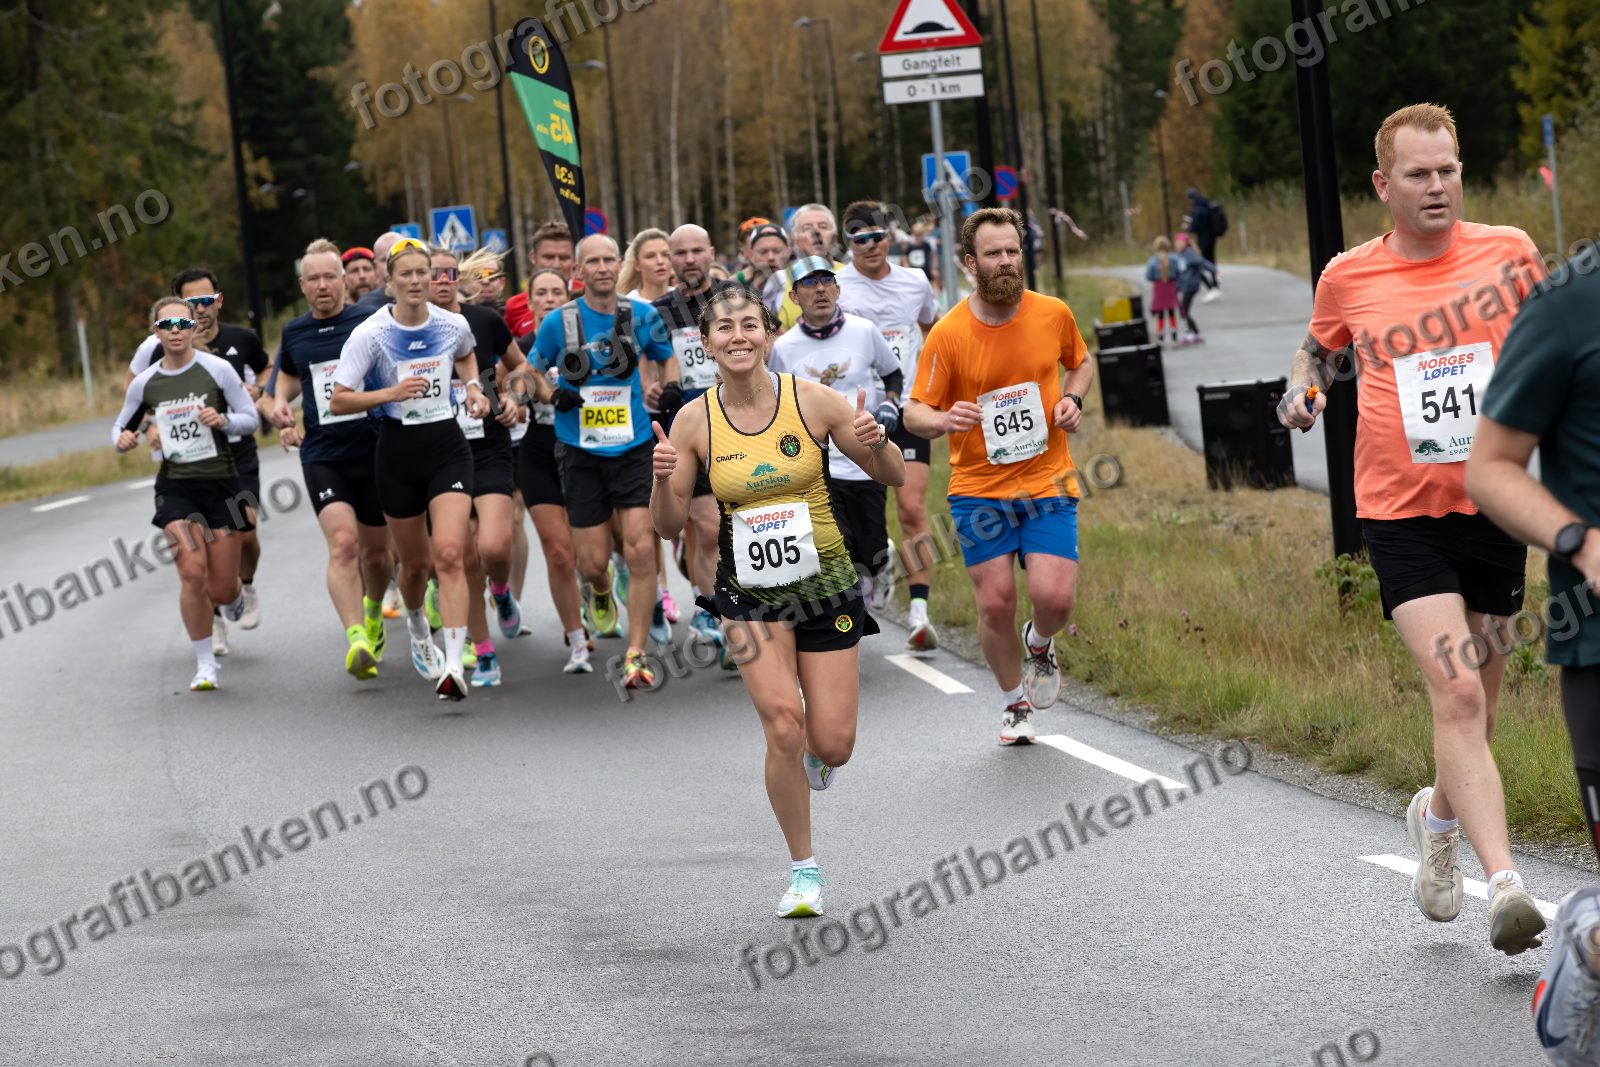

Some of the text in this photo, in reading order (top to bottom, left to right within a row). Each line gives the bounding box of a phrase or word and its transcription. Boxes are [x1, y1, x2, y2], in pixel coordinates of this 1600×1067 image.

[901, 55, 962, 72] Gangfelt
[1416, 352, 1475, 371] NORGES
[1423, 364, 1467, 381] LØPET
[991, 388, 1029, 403] NORGES
[995, 396, 1024, 409] LØPET
[1421, 383, 1477, 424] 541
[584, 409, 626, 425] PACE
[993, 408, 1034, 437] 645
[170, 421, 201, 441] 452
[1449, 436, 1474, 448] Aur
[715, 453, 740, 463] CRAFT
[745, 473, 792, 491] Aurskog
[745, 509, 796, 527] NORGES
[751, 519, 789, 534] LØPET
[748, 535, 801, 572] 905
